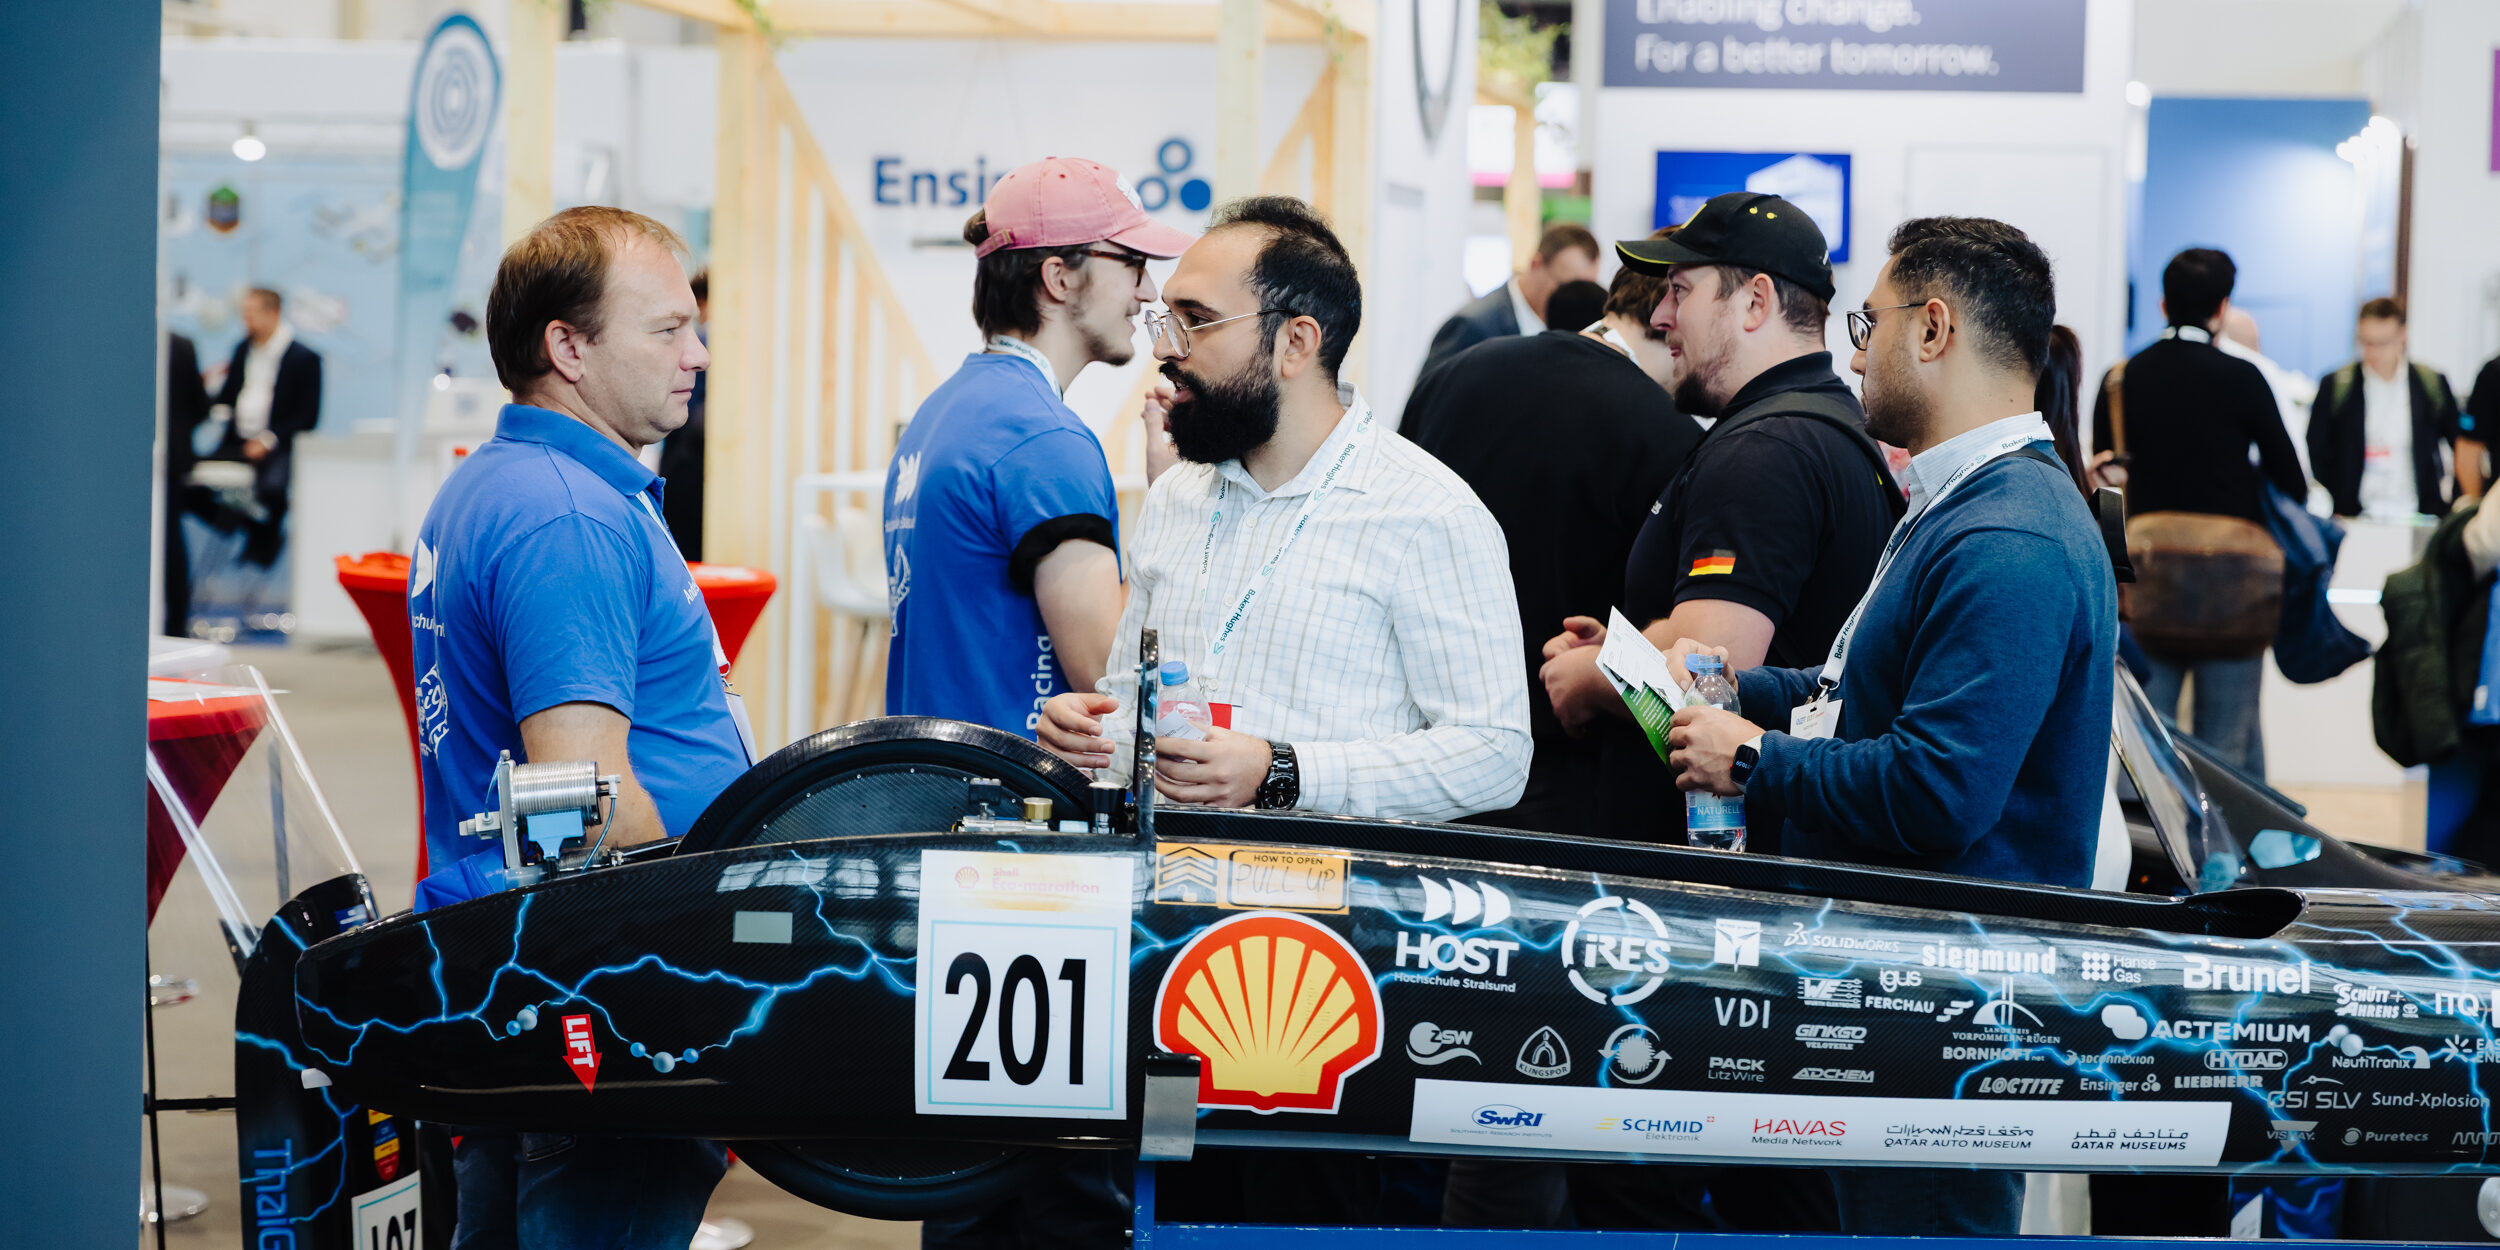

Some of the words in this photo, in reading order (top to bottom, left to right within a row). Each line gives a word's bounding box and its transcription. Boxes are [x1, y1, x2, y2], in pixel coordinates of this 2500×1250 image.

[1635, 33, 1693, 73] For
[1693, 41, 1719, 73] a
[1723, 35, 1827, 74] better
[1830, 37, 2000, 76] tomorrow.
[874, 155, 1007, 207] Ensi
[1338, 443, 1356, 464] Baker
[1321, 463, 1343, 490] Hughes
[1240, 588, 1256, 612] Baker
[1220, 611, 1242, 642] Hughes
[1834, 635, 1846, 660] Baker
[1697, 805, 1741, 816] NATURELL
[1254, 855, 1278, 863] HOW
[1282, 856, 1294, 864] TO
[1297, 857, 1323, 865] OPEN
[993, 867, 1019, 877] Shell
[1235, 864, 1296, 896] PULL
[1306, 867, 1336, 892] UP
[992, 879, 1100, 894] Eco-marathon
[1812, 935, 1901, 953] SOLIDWORKS
[1395, 931, 1520, 976] HOST
[1922, 940, 2057, 976] siegmund
[2114, 954, 2157, 970] Hanse
[1394, 972, 1460, 988] Hochschule
[1462, 977, 1516, 993] Stralsund
[1880, 968, 1923, 993] igus
[2114, 968, 2141, 984] Gas
[2183, 954, 2311, 995] Brunel
[1714, 996, 1771, 1029] VDI
[1865, 995, 1935, 1014] FERCHAU
[2435, 991, 2480, 1017] ITQ
[943, 952, 1087, 1086] 201
[1430, 1029, 1473, 1046] ZSW
[1795, 1024, 1867, 1040] GINKGO
[2151, 1020, 2311, 1043] ACTEMIUM
[566, 1017, 595, 1068] LIFT
[1709, 1056, 1766, 1072] PACK
[2209, 1051, 2283, 1069] HYDAC
[2332, 1055, 2410, 1069] NautiTronix
[1518, 1062, 1568, 1077] KLINGSPOR
[1732, 1071, 1765, 1083] Wire
[1792, 1067, 1875, 1083] ADCHEM
[1978, 1077, 2064, 1095] LOCTITE
[2080, 1078, 2139, 1095] Ensinger
[2174, 1075, 2263, 1089] LIEBHERR
[2267, 1091, 2308, 1109] GSI
[2315, 1091, 2362, 1109] SLV
[2371, 1091, 2491, 1110] Sund-Xplosion
[1478, 1110, 1544, 1126] SwRI
[1622, 1118, 1703, 1133] SCHMID
[1753, 1118, 1847, 1137] HAVAS
[1645, 1132, 1700, 1142] Elektronik
[1751, 1136, 1788, 1146] Media
[1791, 1137, 1843, 1147] Network
[1884, 1138, 1928, 1148] QATAR
[1931, 1139, 1968, 1148] AUTO
[1972, 1140, 2032, 1149] MUSEUM
[2071, 1141, 2114, 1150] QATAR
[2119, 1141, 2187, 1150] MUSEUMS
[2365, 1131, 2429, 1143] Puretecs
